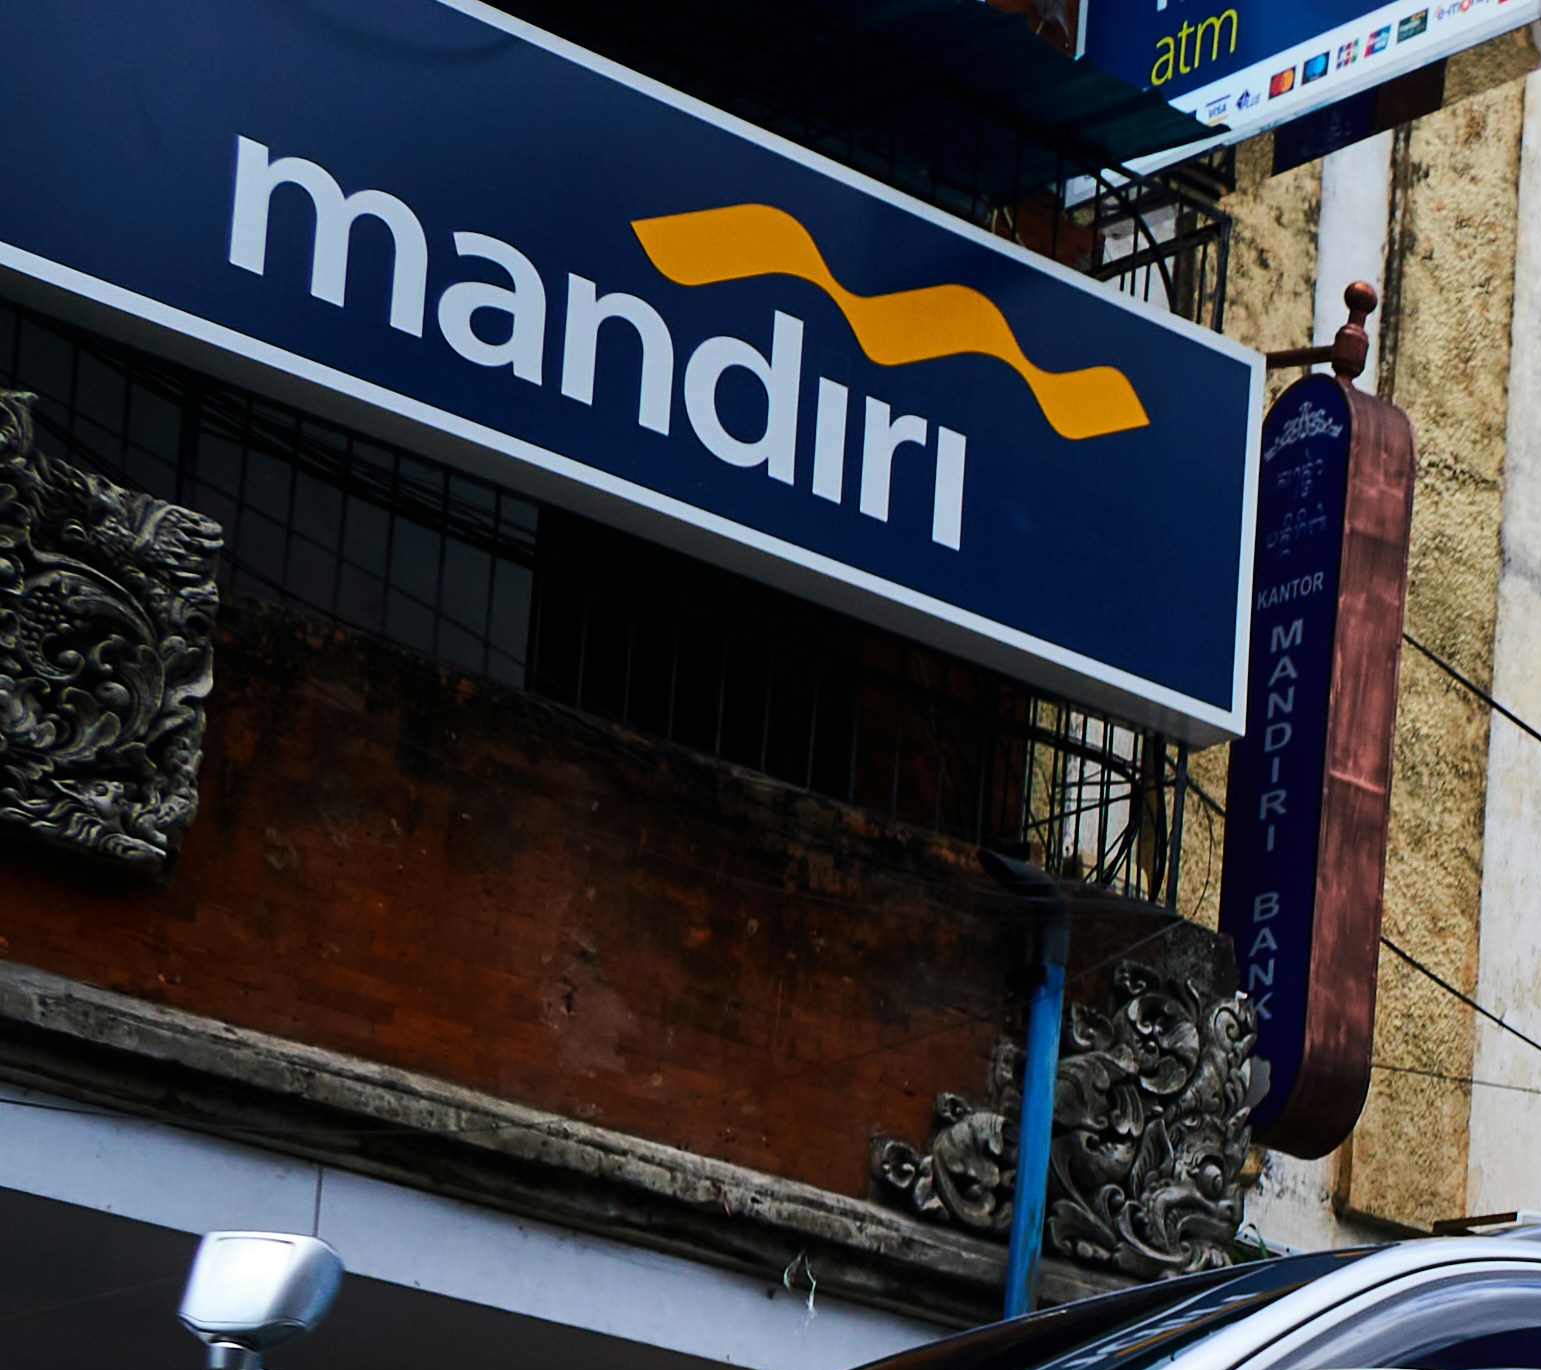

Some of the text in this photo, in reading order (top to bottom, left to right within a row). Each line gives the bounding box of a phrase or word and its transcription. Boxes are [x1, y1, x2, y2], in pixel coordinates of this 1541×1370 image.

[1151, 8, 1238, 86] atm
[229, 134, 970, 551] mandiri
[1257, 572, 1324, 611] KANTOR
[1247, 618, 1304, 1021] MANDIRI BANK
